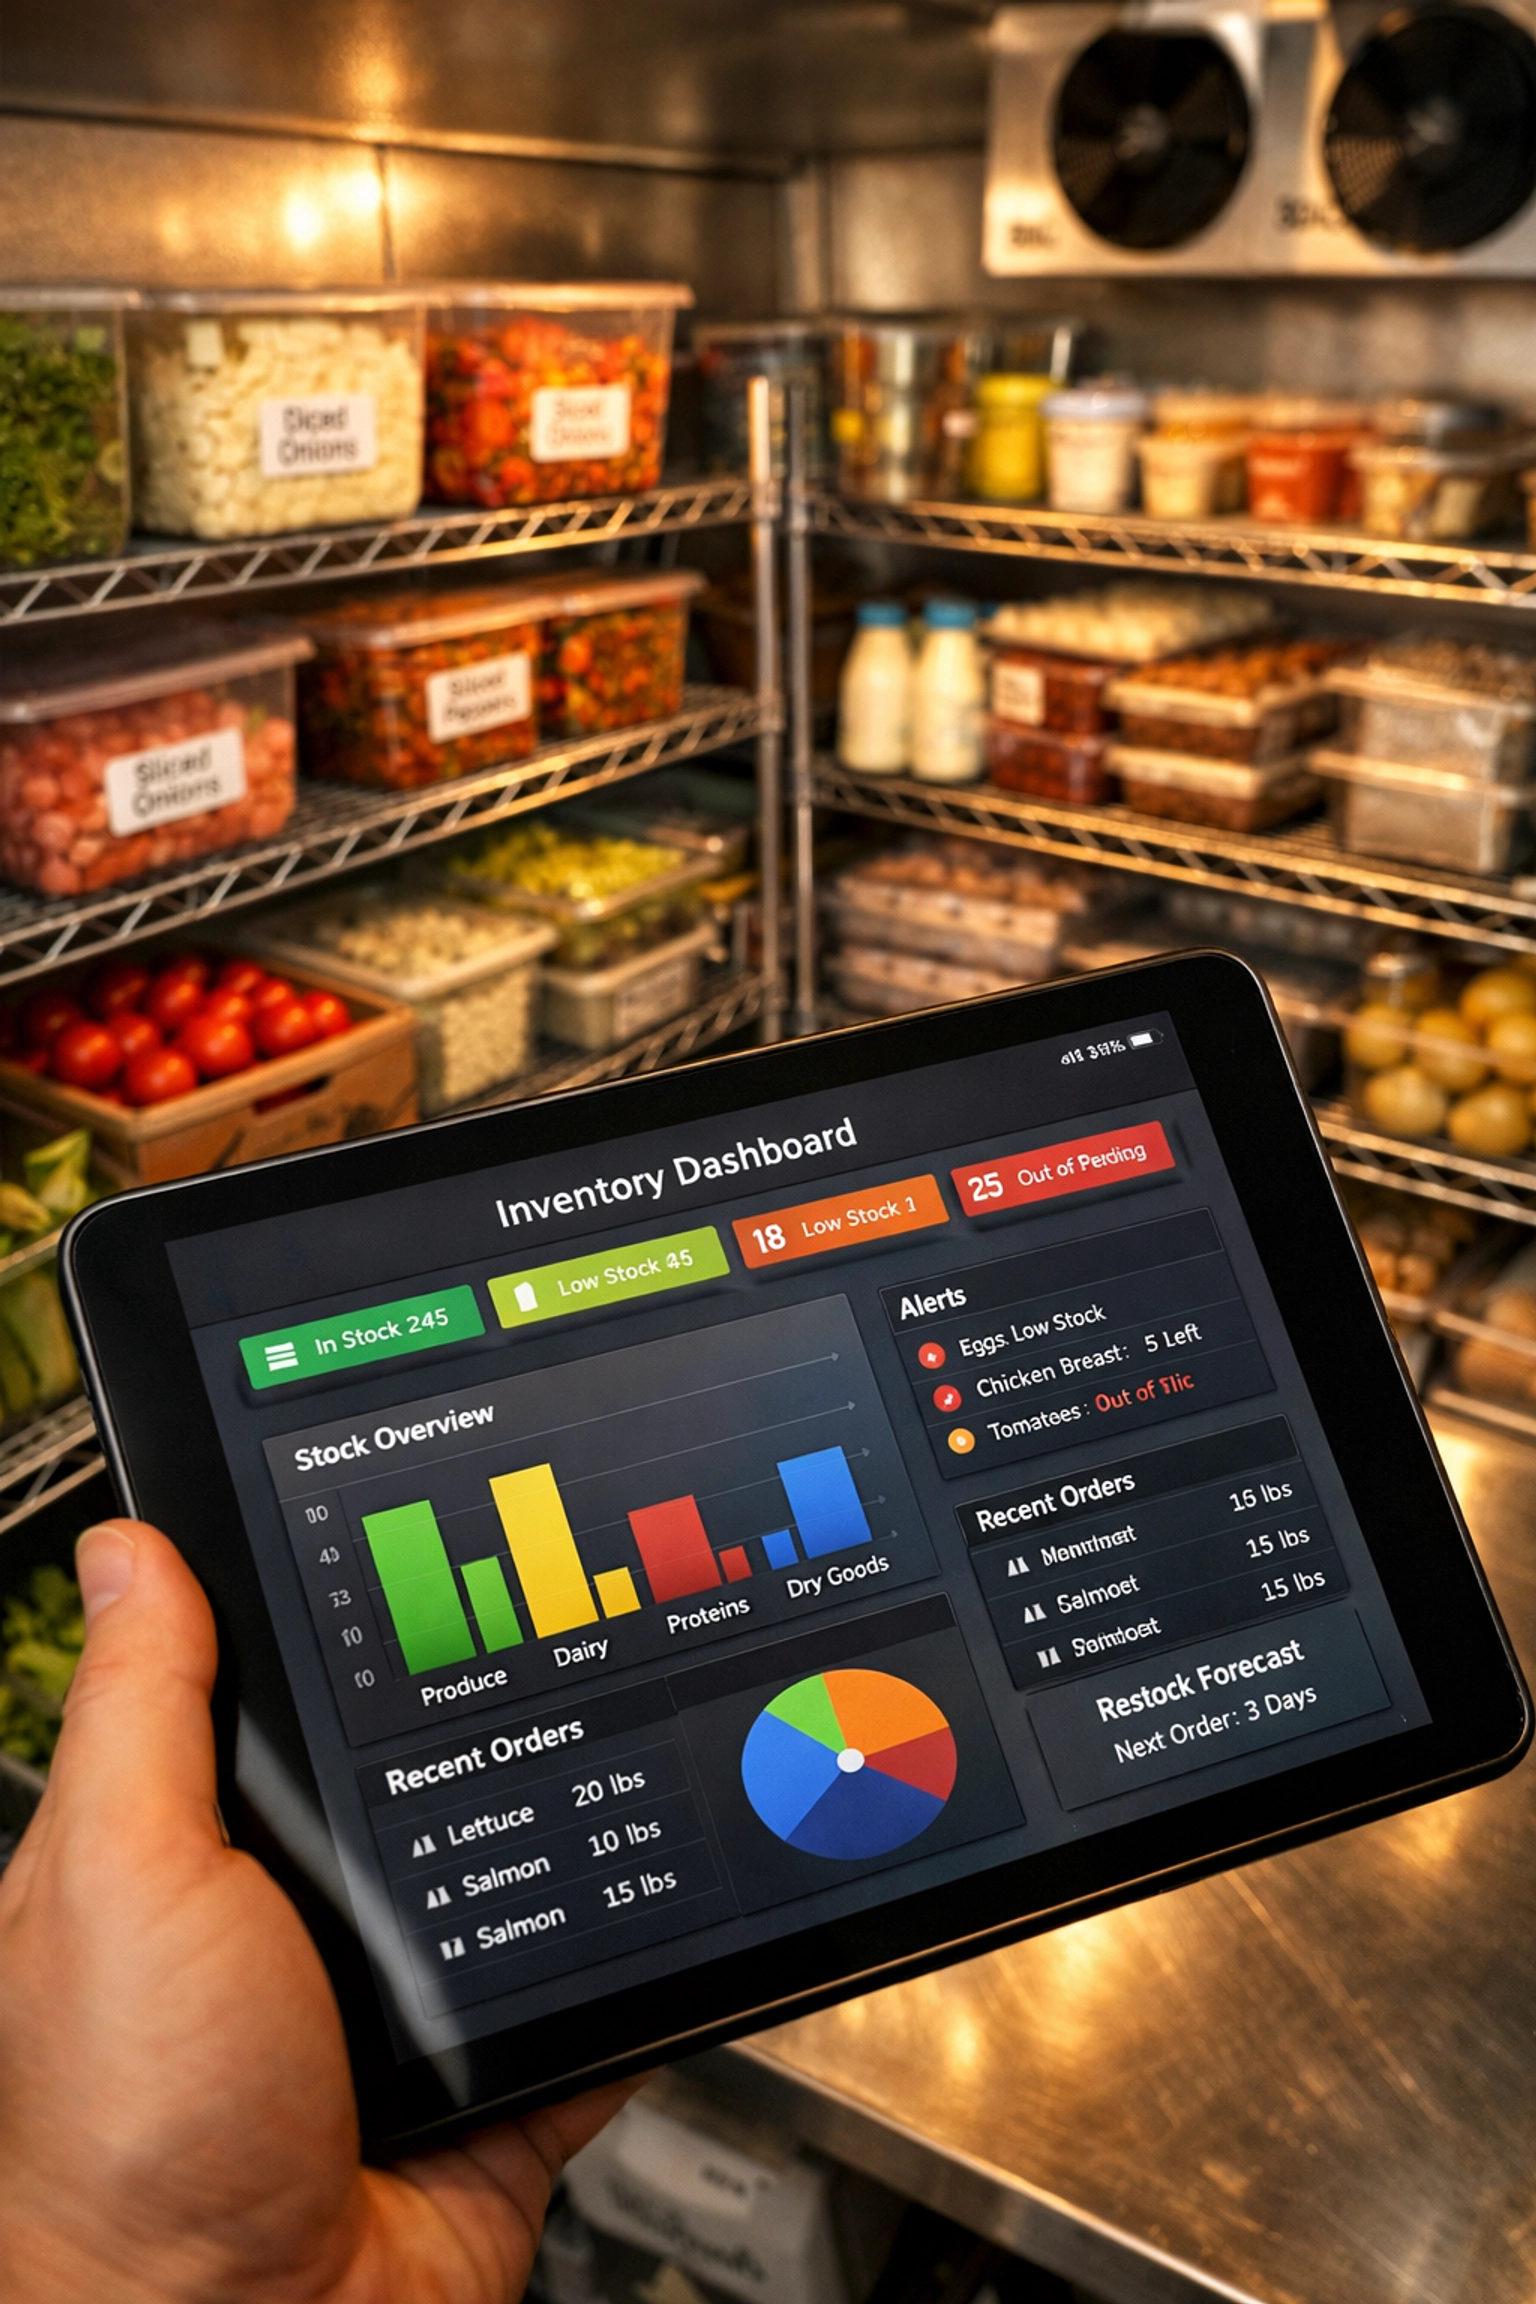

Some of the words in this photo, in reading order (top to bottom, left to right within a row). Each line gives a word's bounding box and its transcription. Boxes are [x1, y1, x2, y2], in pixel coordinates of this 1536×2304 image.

[496, 1168, 665, 1228] Inventory
[673, 1117, 857, 1186] Dashboard
[968, 1172, 1004, 1202] 25
[1017, 1164, 1053, 1186] Out
[1057, 1157, 1074, 1177] of
[752, 1223, 786, 1254] 18
[801, 1217, 842, 1238] Low
[846, 1200, 901, 1226] Stock
[557, 1275, 600, 1297] Low
[604, 1257, 661, 1285] Stock
[900, 1286, 967, 1320] Alerts
[1010, 1321, 1049, 1342] Low
[1053, 1304, 1107, 1331] Stock
[315, 1336, 338, 1356] In
[342, 1319, 402, 1350] Stock
[406, 1308, 449, 1335] 245
[976, 1366, 1056, 1398] Chicken
[1059, 1344, 1131, 1375] Breast:
[1144, 1335, 1159, 1353] 5
[1162, 1322, 1202, 1349] Left
[1094, 1389, 1133, 1412] Out
[1136, 1379, 1156, 1402] of
[294, 1434, 371, 1471] Stock
[374, 1406, 494, 1450] Overview
[975, 1496, 1057, 1533] Recent
[1060, 1474, 1136, 1508] Orders
[1229, 1489, 1257, 1512] 16
[1260, 1484, 1293, 1503] lbs
[1245, 1535, 1274, 1558] 15
[1278, 1530, 1310, 1549] lbs
[786, 1573, 822, 1598] Dry
[826, 1555, 890, 1588] Goods
[1261, 1578, 1289, 1601] 15
[1292, 1572, 1326, 1592] lbs
[666, 1597, 750, 1634] Proteins
[553, 1636, 609, 1668] Dairy
[420, 1669, 508, 1706] Produce
[1095, 1673, 1196, 1722] Restock
[1197, 1639, 1305, 1691] Forecast
[1114, 1730, 1167, 1763] Next
[1170, 1711, 1240, 1744] Order:
[1244, 1699, 1260, 1721] 3
[1264, 1687, 1317, 1716] Days
[385, 1748, 486, 1795] Recent
[490, 1719, 584, 1763] Orders
[447, 1806, 535, 1846] Lettuce
[571, 1780, 604, 1807] 20
[609, 1771, 646, 1795] lbs
[462, 1856, 551, 1897] Salmon
[588, 1830, 619, 1857] 10
[625, 1820, 661, 1845] lbs
[476, 1907, 566, 1949] Salmon
[602, 1880, 635, 1908] 15
[640, 1871, 677, 1896] lbs
